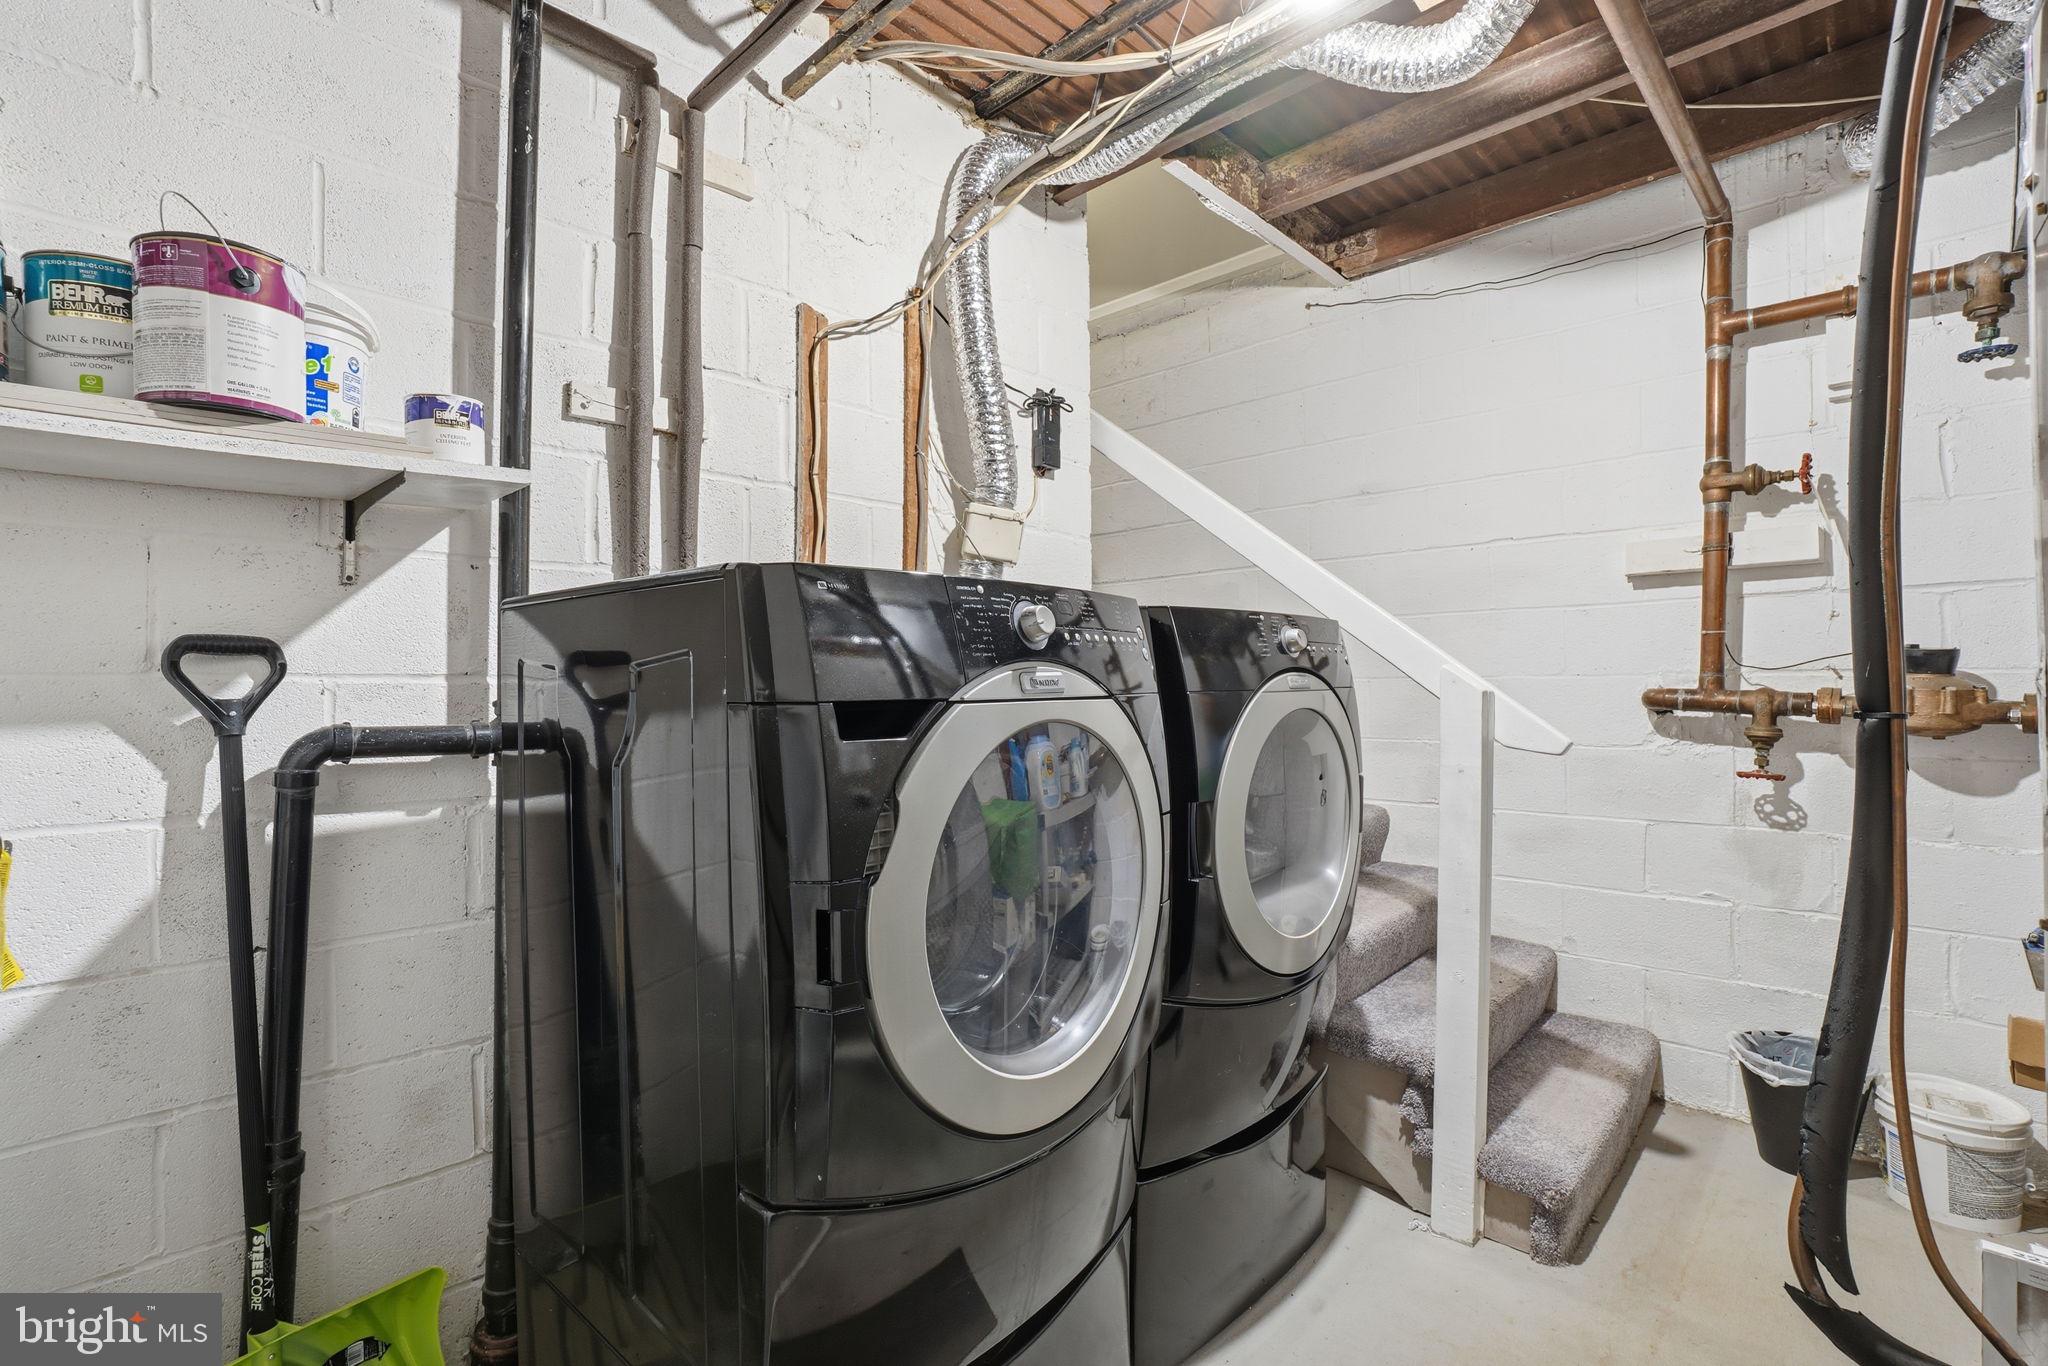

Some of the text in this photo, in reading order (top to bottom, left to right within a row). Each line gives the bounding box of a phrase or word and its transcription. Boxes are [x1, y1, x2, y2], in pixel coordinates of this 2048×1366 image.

[67, 260, 115, 272] SEMI-GLOSS
[51, 283, 105, 304] BEHR
[51, 300, 100, 313] PREMIUM
[103, 304, 130, 317] PLUS
[46, 334, 77, 343] PAINT
[79, 336, 89, 344] &
[251, 1235, 266, 1311] STEELCORE
